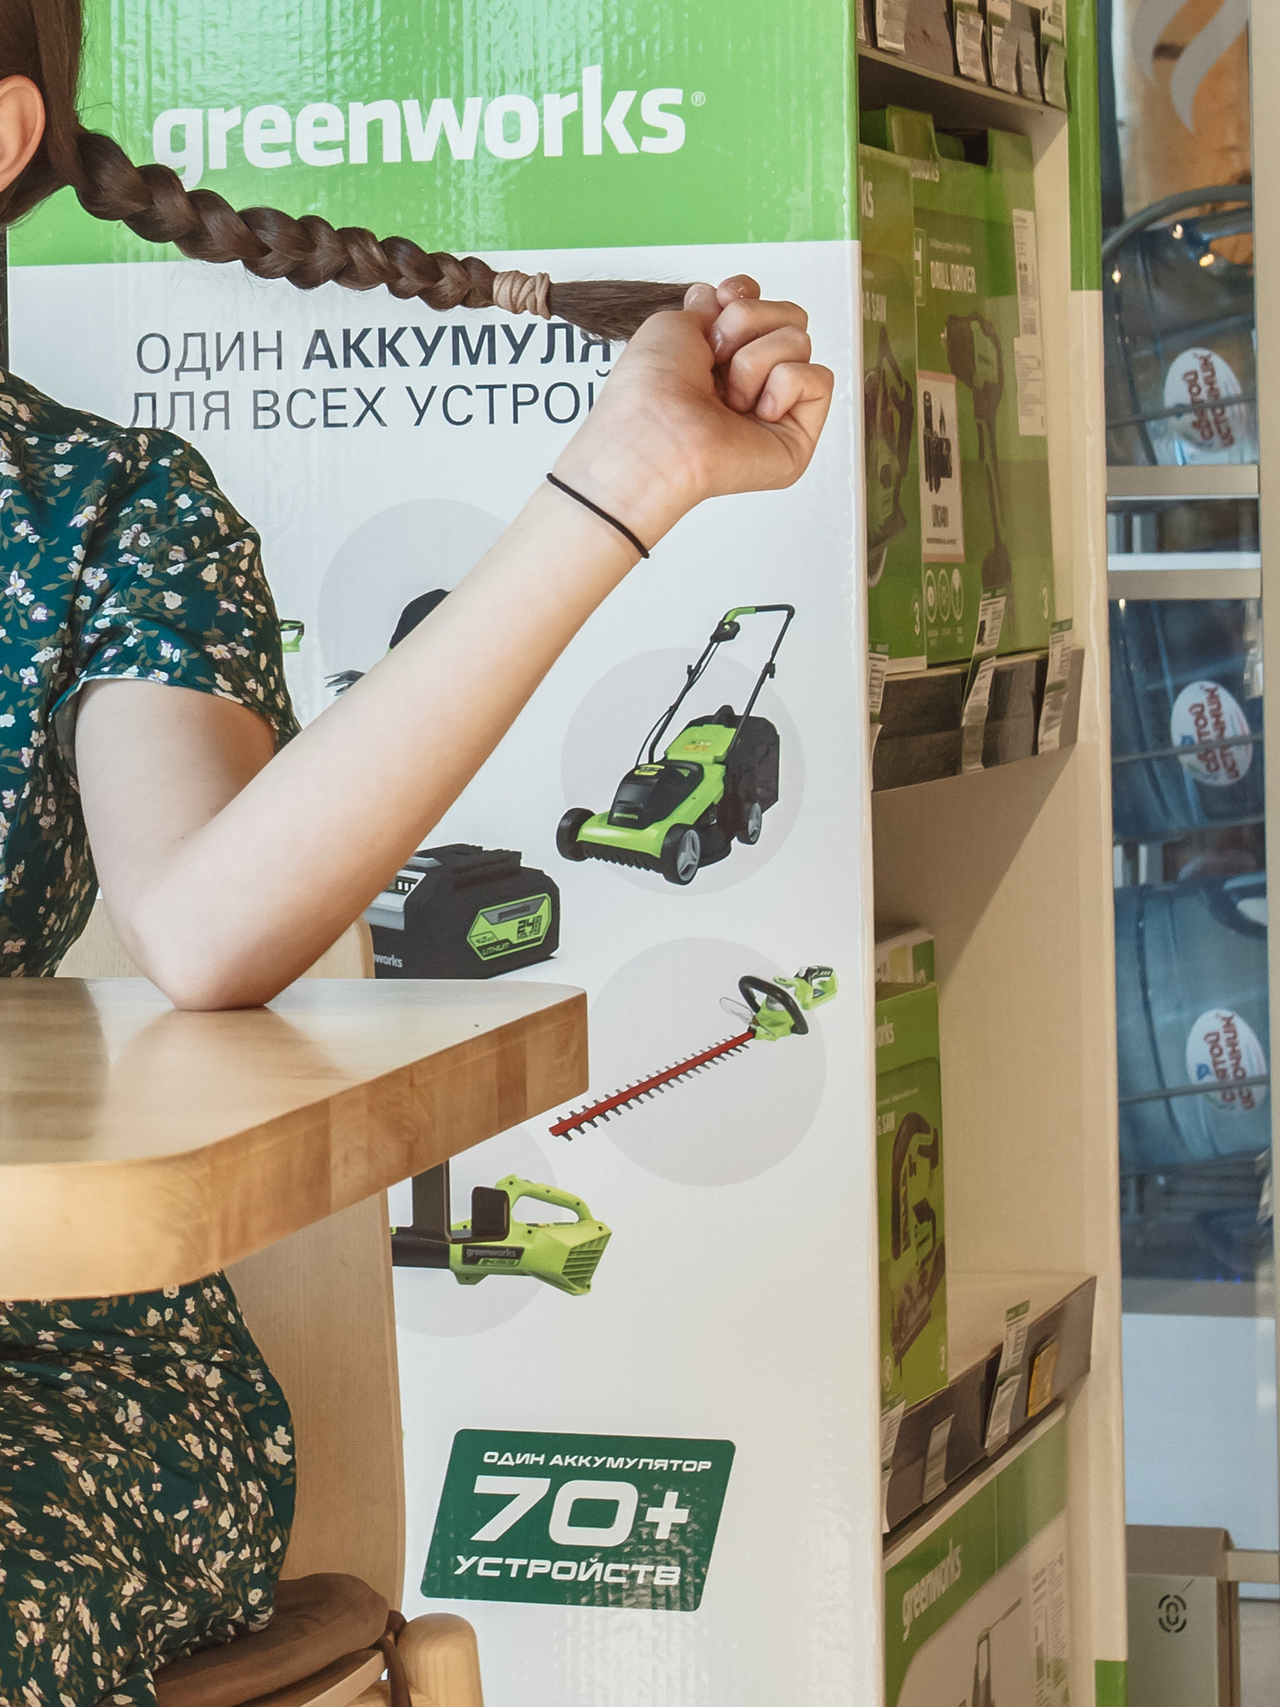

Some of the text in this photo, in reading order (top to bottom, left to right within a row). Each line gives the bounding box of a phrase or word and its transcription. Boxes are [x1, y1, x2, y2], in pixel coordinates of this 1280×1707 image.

[152, 65, 685, 188] greenworks
[136, 330, 284, 381] ОДИН
[129, 390, 231, 431] ДЛЯ
[252, 385, 388, 431] ВСЕХ
[466, 1247, 516, 1258] greenworks
[483, 1450, 712, 1473] ОДИН АККУМУЛЯТОР
[470, 1474, 690, 1548] 70+
[453, 1555, 681, 1586] УСТРОЙСТВ
[902, 1538, 961, 1642] greenworks
